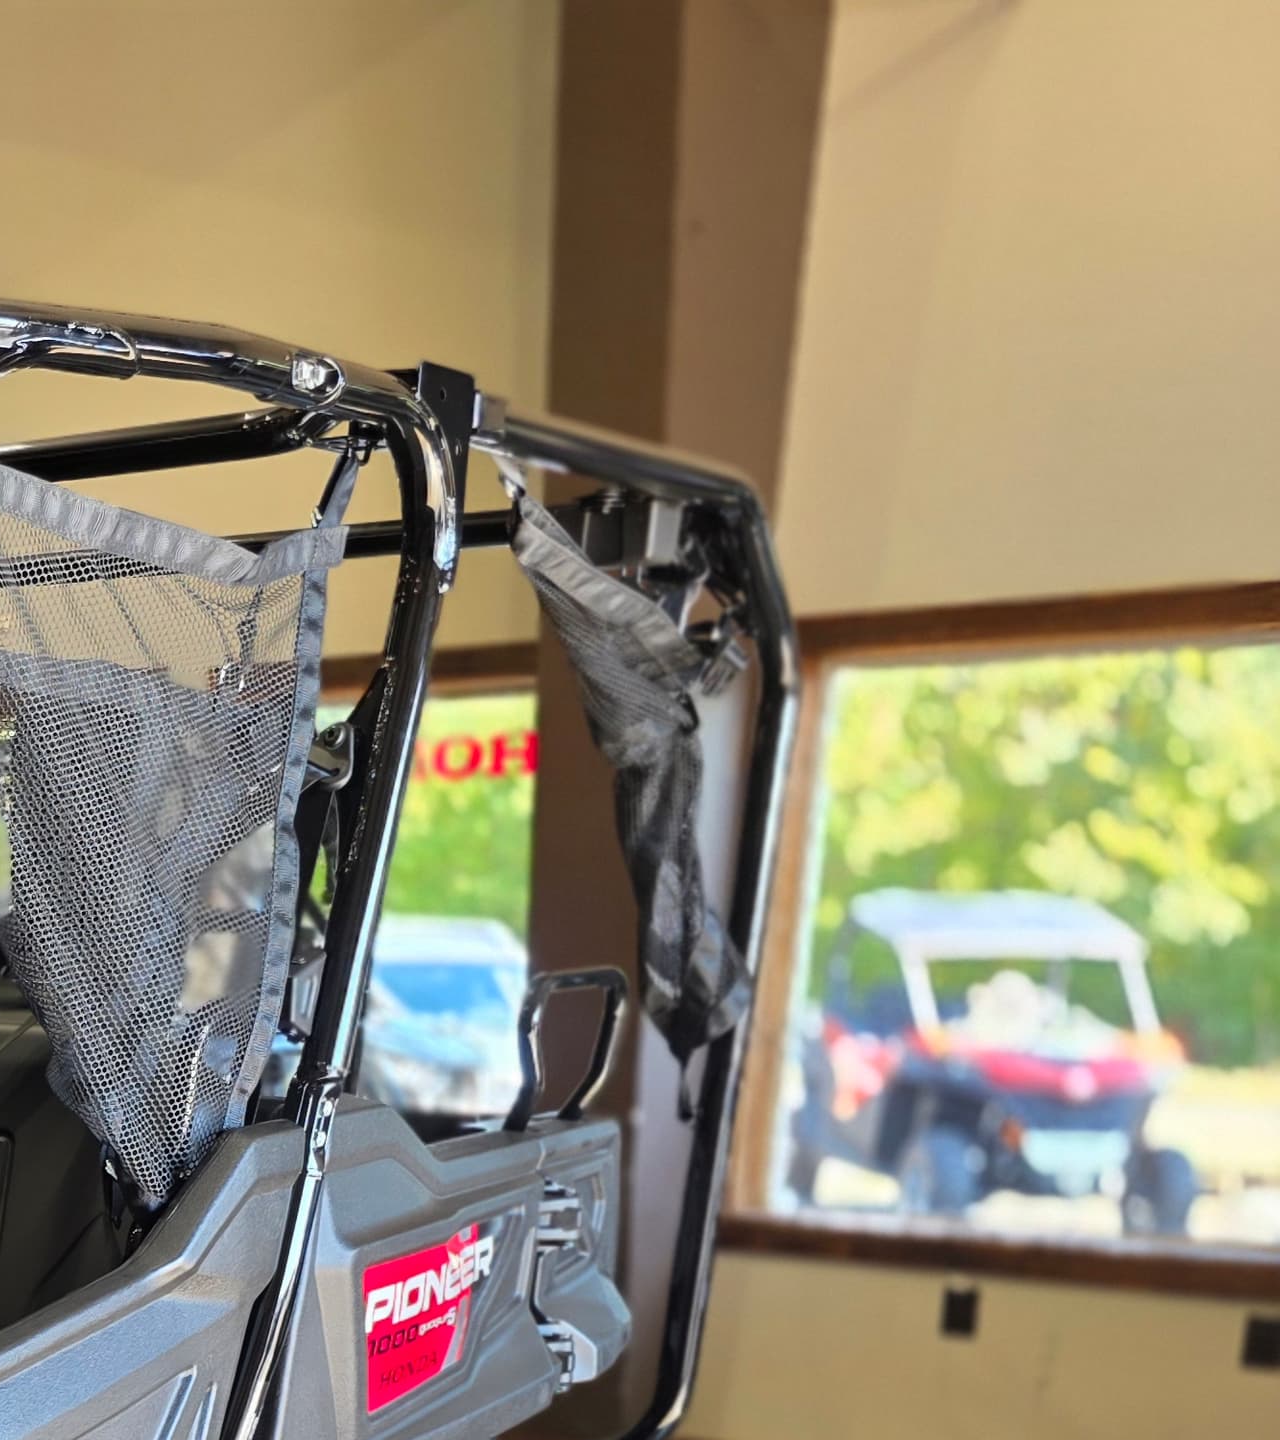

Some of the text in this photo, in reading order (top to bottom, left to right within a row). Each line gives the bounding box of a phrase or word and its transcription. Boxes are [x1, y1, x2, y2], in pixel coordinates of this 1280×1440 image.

[365, 1236, 494, 1334] PIONEER
[368, 1323, 419, 1359] 1000
[380, 1351, 438, 1387] HONDA
